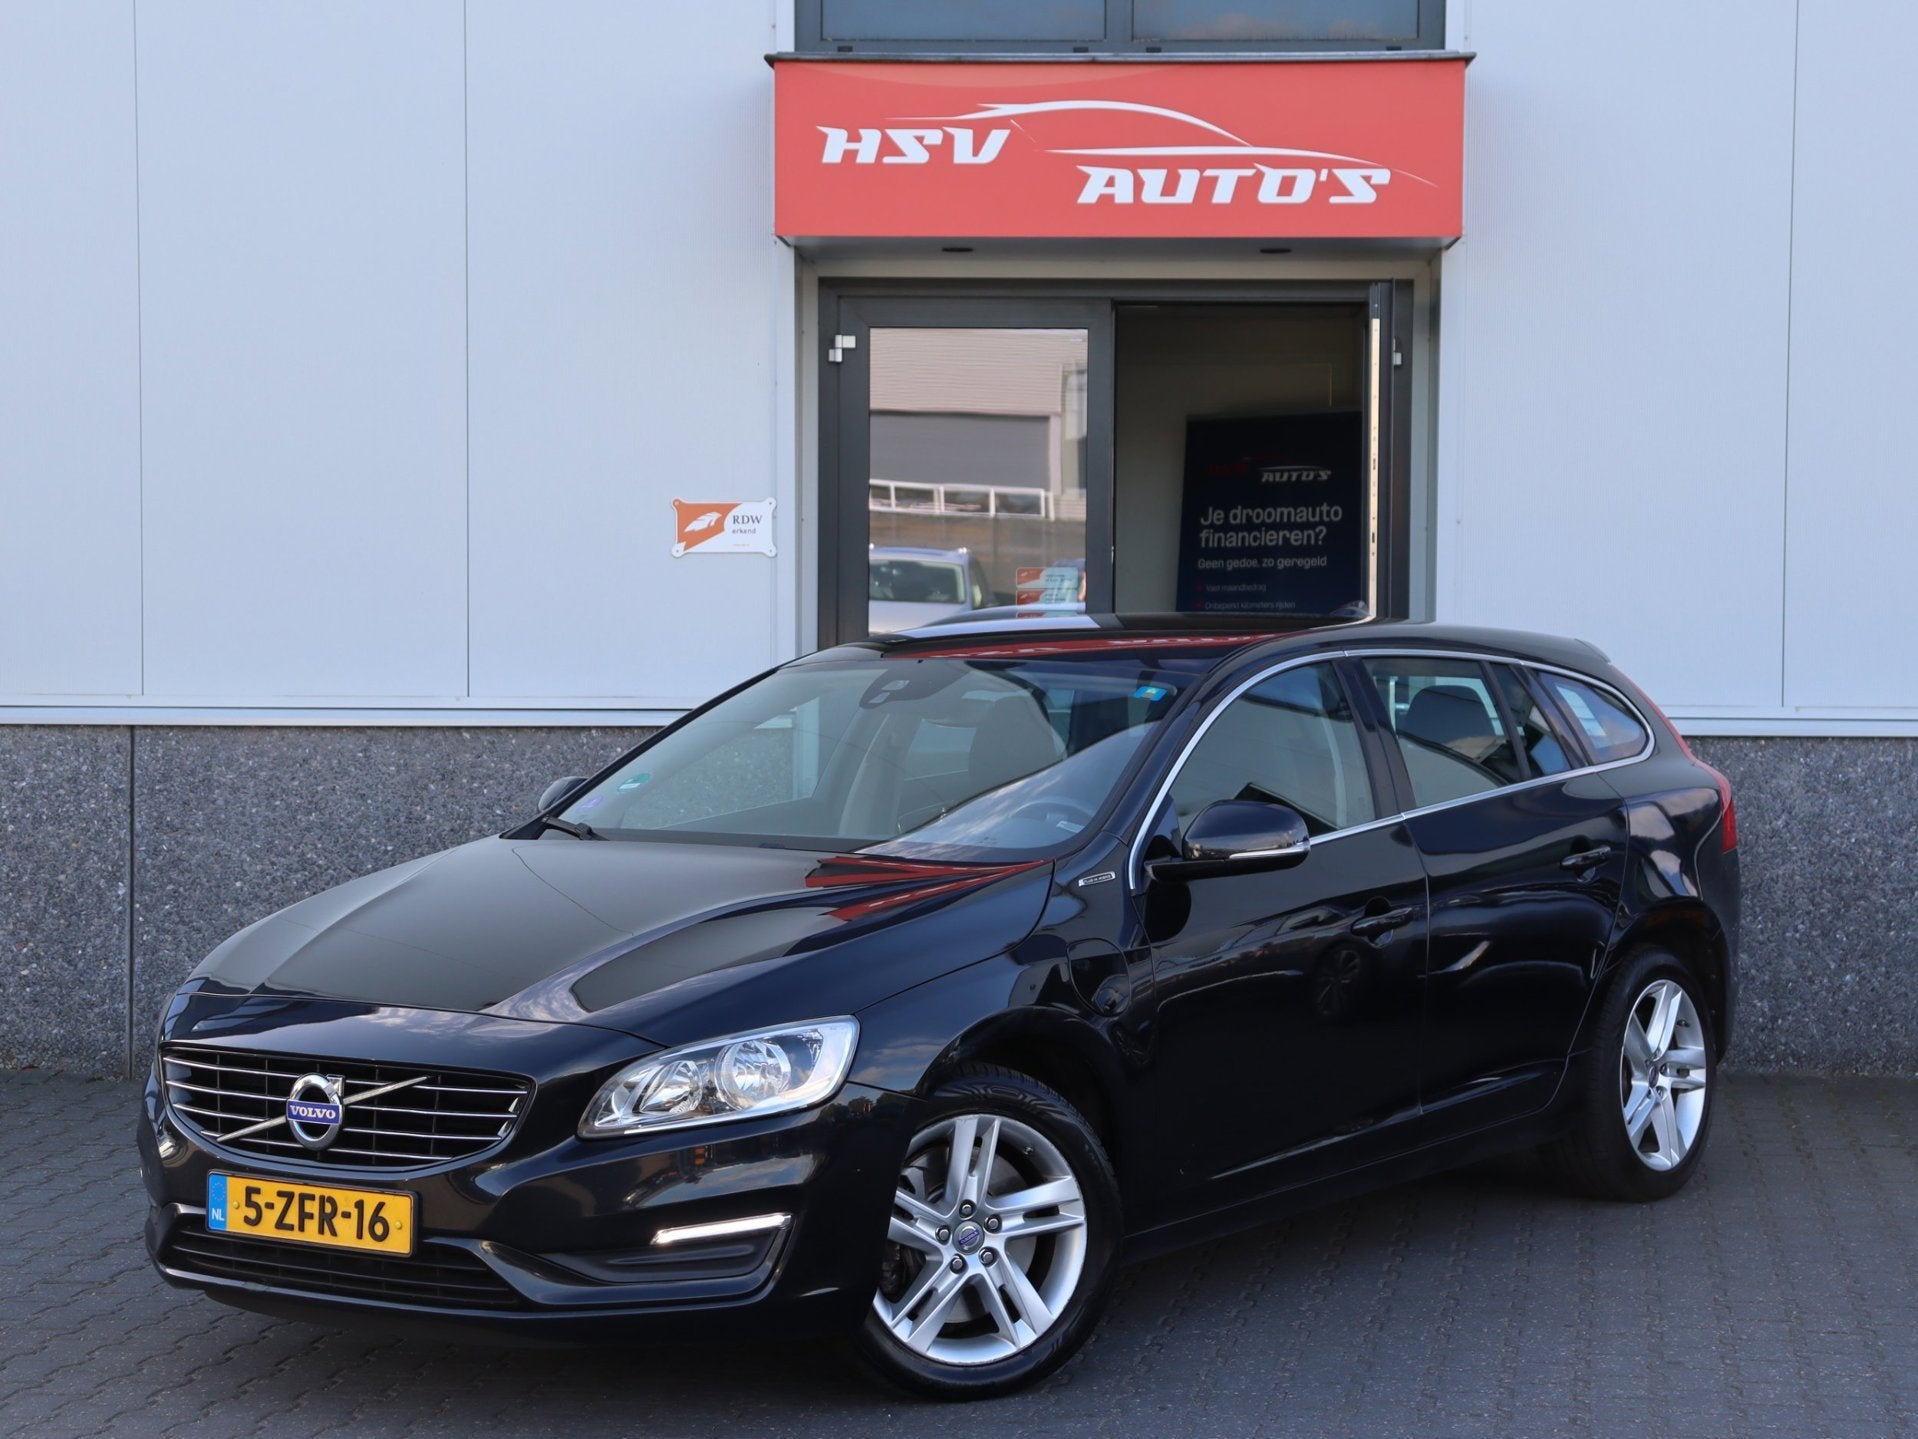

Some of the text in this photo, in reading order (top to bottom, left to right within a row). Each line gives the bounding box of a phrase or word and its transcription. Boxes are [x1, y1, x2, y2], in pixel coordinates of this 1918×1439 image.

[816, 125, 1010, 163] HSV
[1076, 164, 1391, 204] AUTO'S
[1261, 470, 1332, 482] AUTO'S
[733, 515, 762, 525] RDW
[1200, 503, 1343, 525] Je droomauto
[1199, 526, 1327, 548] financieren?
[1198, 558, 1224, 569] Geen
[1262, 558, 1274, 568] zo
[1277, 556, 1327, 570] geregeld
[290, 1104, 336, 1119] VOLVO
[212, 1209, 225, 1221] NL
[243, 1186, 390, 1243] 5-ZFR-16
